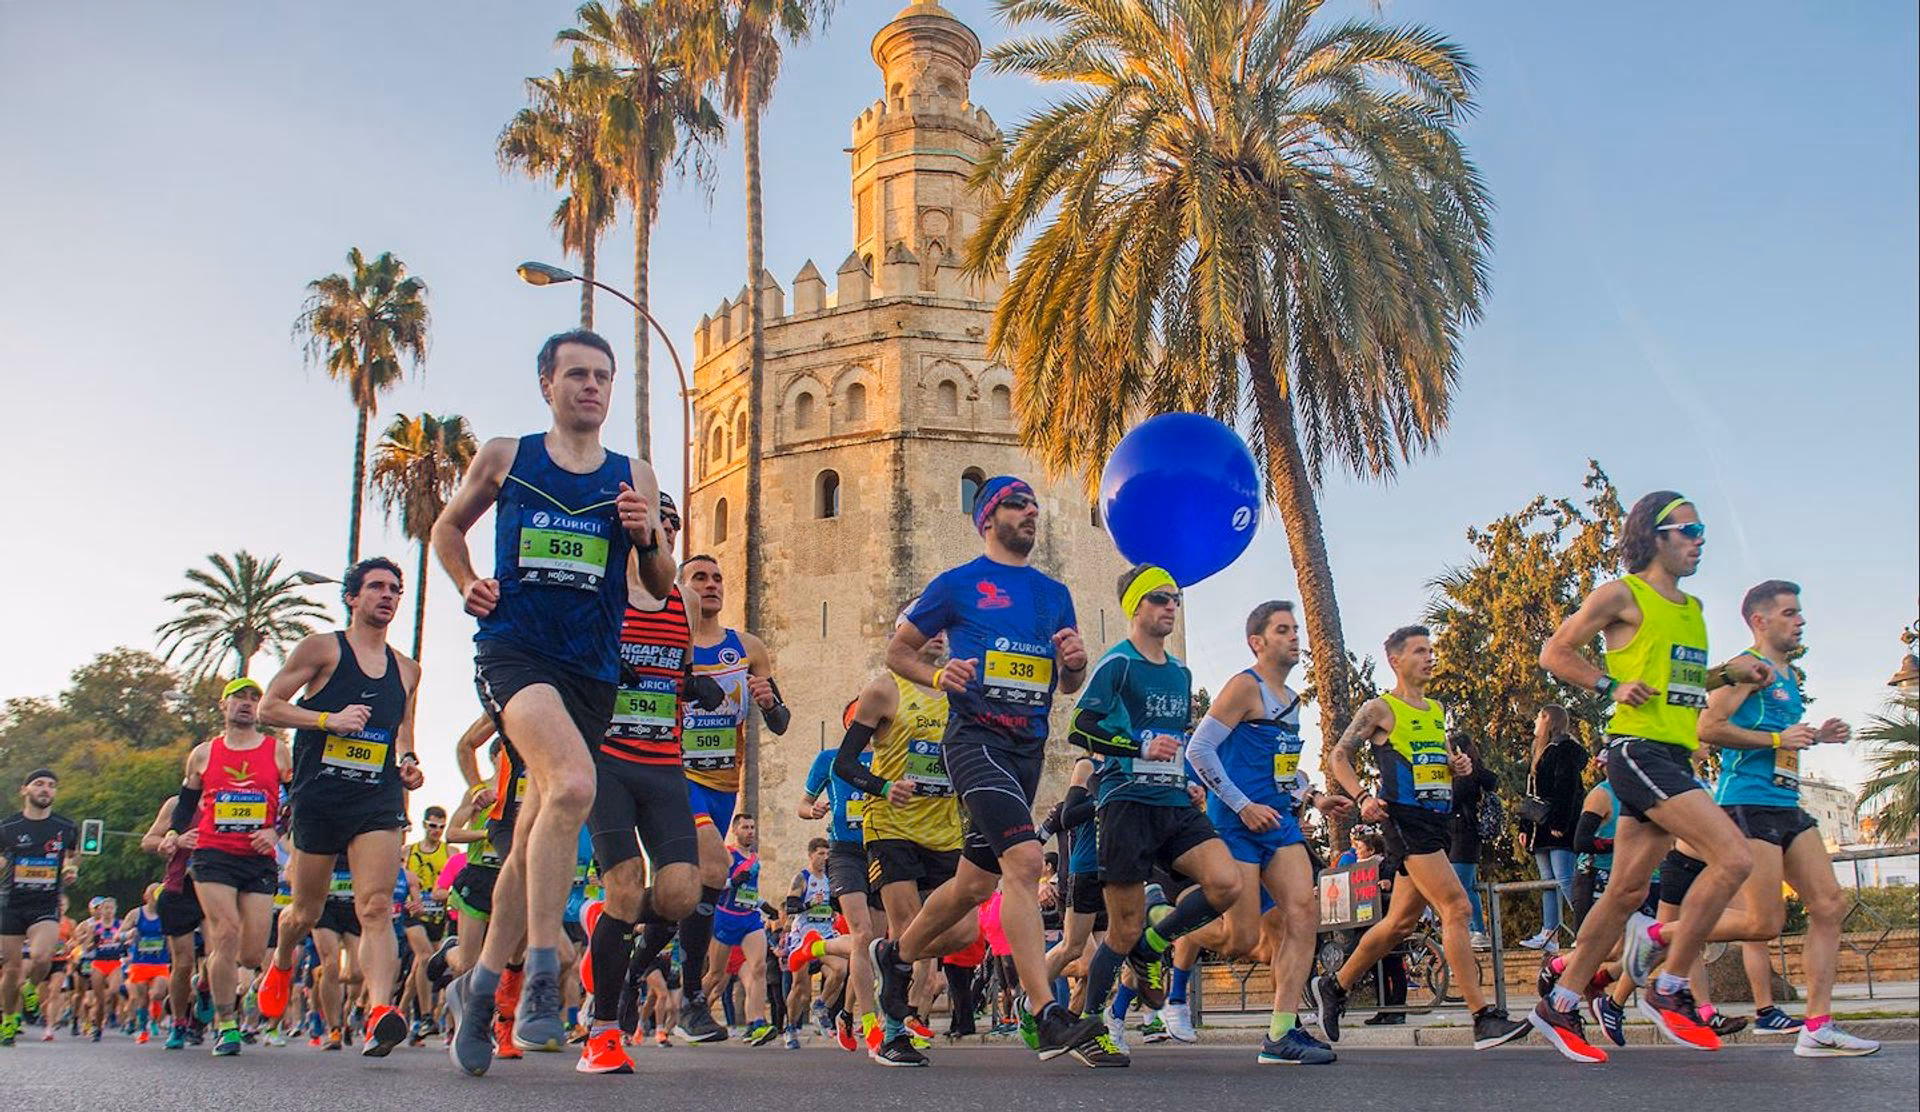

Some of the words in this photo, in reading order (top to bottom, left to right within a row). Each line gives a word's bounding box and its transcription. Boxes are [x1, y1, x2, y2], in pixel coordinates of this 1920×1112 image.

[553, 516, 601, 533] ZURICH
[549, 539, 583, 557] 538
[620, 643, 684, 659] NGAPORE
[1011, 641, 1046, 655] ZURICH
[1009, 661, 1034, 678] 338
[639, 680, 671, 691] URICH
[629, 698, 657, 712] 594
[697, 718, 730, 727] ZURICH
[697, 735, 720, 748] 509
[346, 745, 372, 760] 380
[231, 808, 251, 817] 328
